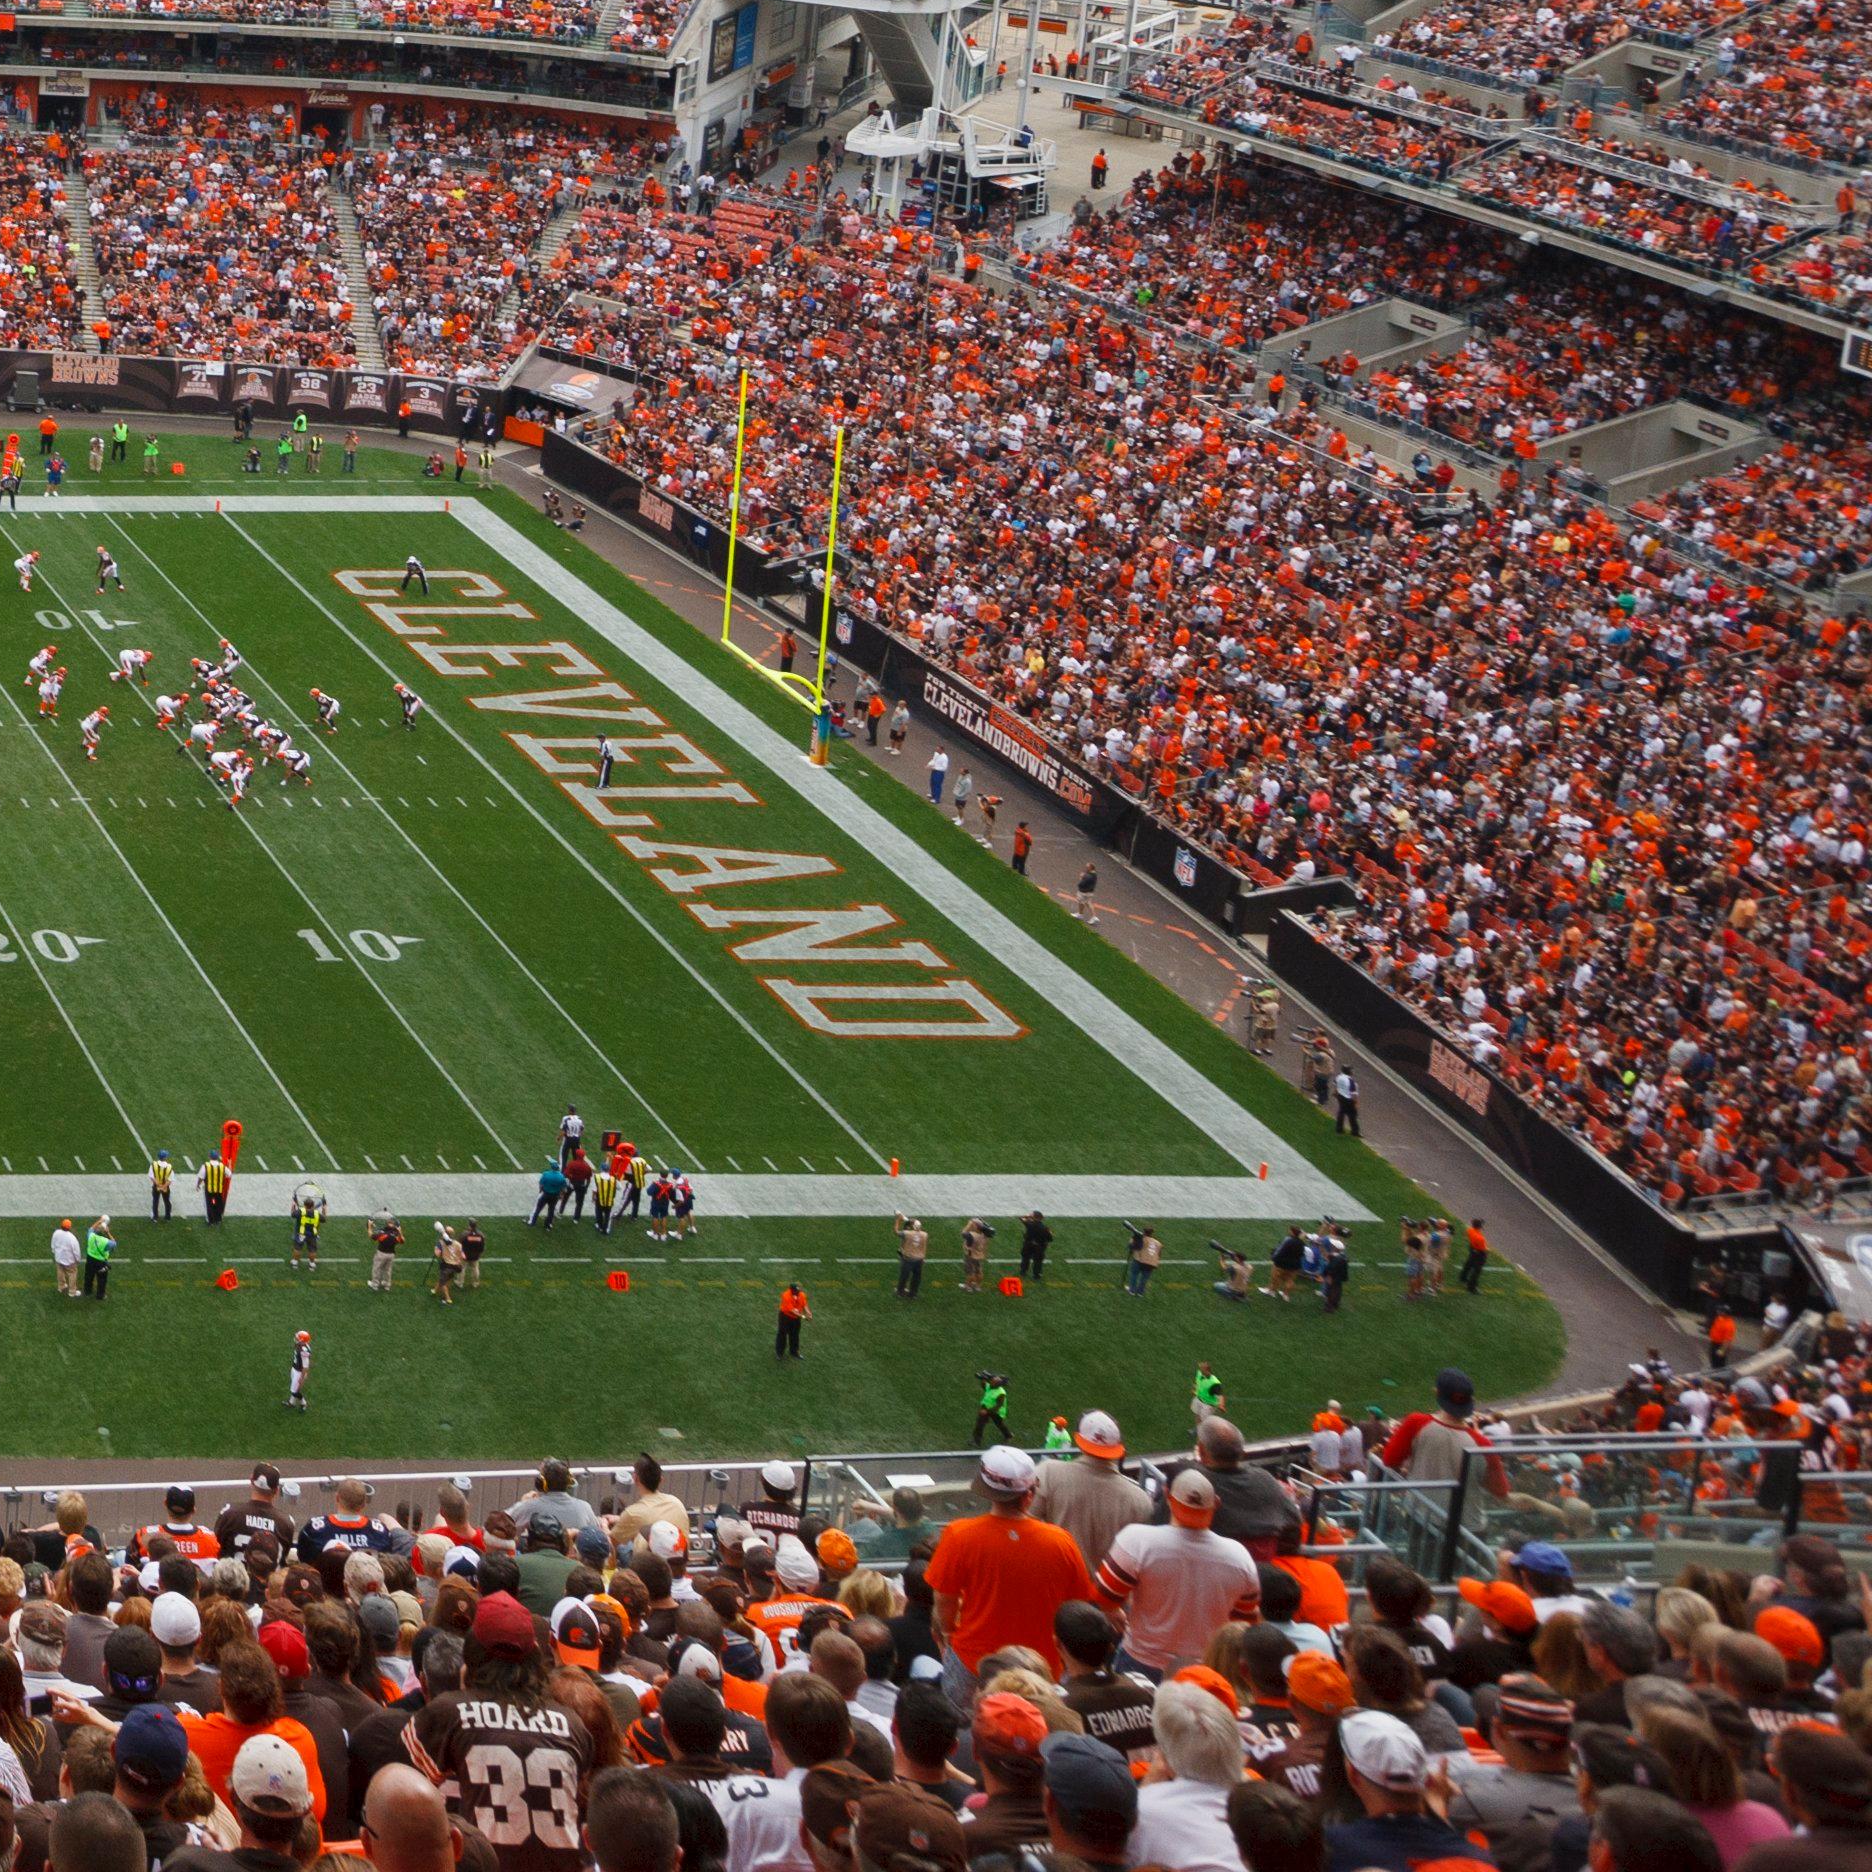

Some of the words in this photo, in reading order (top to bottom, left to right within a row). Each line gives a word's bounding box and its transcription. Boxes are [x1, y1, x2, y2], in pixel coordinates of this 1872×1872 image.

[52, 354, 119, 371] CLEVELAND
[52, 368, 119, 386] BROWNS
[192, 371, 207, 382] 71
[300, 378, 321, 389] 98
[357, 382, 377, 393] 23
[420, 388, 430, 399] 3
[37, 609, 116, 630] 10
[926, 672, 946, 689] FOR
[948, 686, 988, 718] TICKET
[923, 680, 1093, 815] CLEVELANDBROWNS.COM
[331, 568, 1030, 1039] CLEVELAND
[296, 927, 402, 963] 10
[245, 1514, 275, 1532] HADEN
[335, 1532, 368, 1548] MILLER
[456, 1700, 570, 1738] HOARD
[1087, 1705, 1154, 1737] EDWARDS
[464, 1744, 580, 1848] 33
